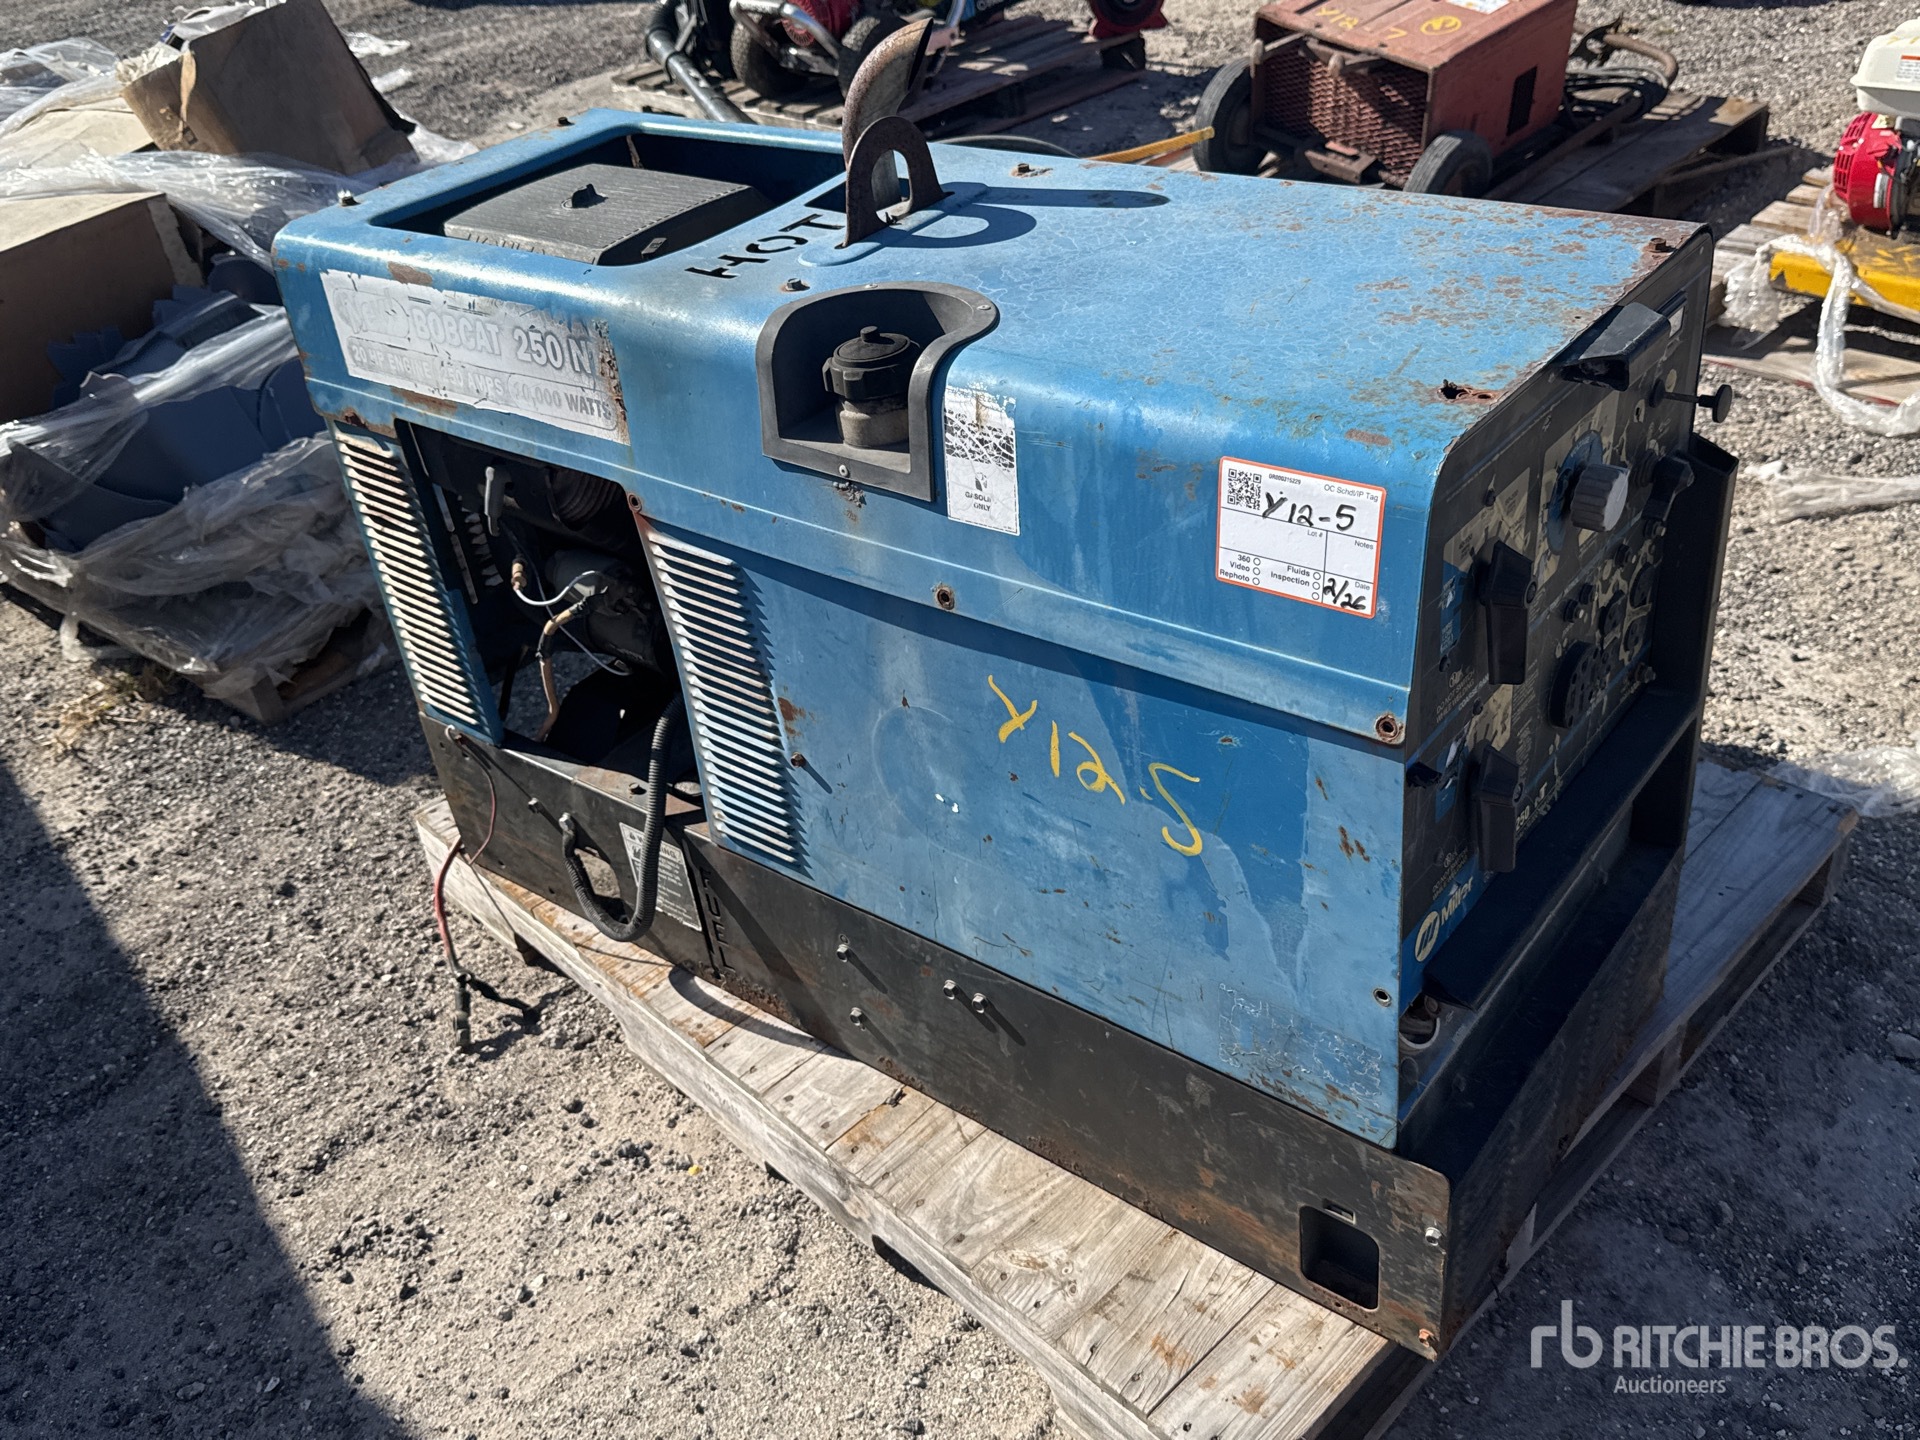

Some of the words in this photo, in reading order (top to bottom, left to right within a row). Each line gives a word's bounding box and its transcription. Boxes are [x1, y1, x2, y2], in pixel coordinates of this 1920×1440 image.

[685, 213, 846, 279] HOT
[411, 306, 500, 356] BOBCAT
[513, 328, 563, 370] 250
[352, 345, 368, 363] 20
[370, 349, 384, 366] HP
[389, 352, 432, 379] ENGINE
[468, 373, 503, 396] AMPS
[563, 392, 612, 420] WATTS
[1366, 493, 1379, 502] Tag
[973, 502, 991, 512] ONLY
[1262, 491, 1357, 531] Y12-5
[1354, 540, 1374, 550] Notes
[1237, 554, 1251, 563] 360
[1229, 561, 1251, 572] Video
[1286, 565, 1311, 577] Fluids
[1219, 569, 1250, 583] Rephoto
[1270, 571, 1310, 587] Inspection
[1354, 581, 1371, 591] Date
[1323, 578, 1366, 610] 2/26
[1440, 875, 1474, 926] Miller
[699, 867, 737, 972] FUEL
